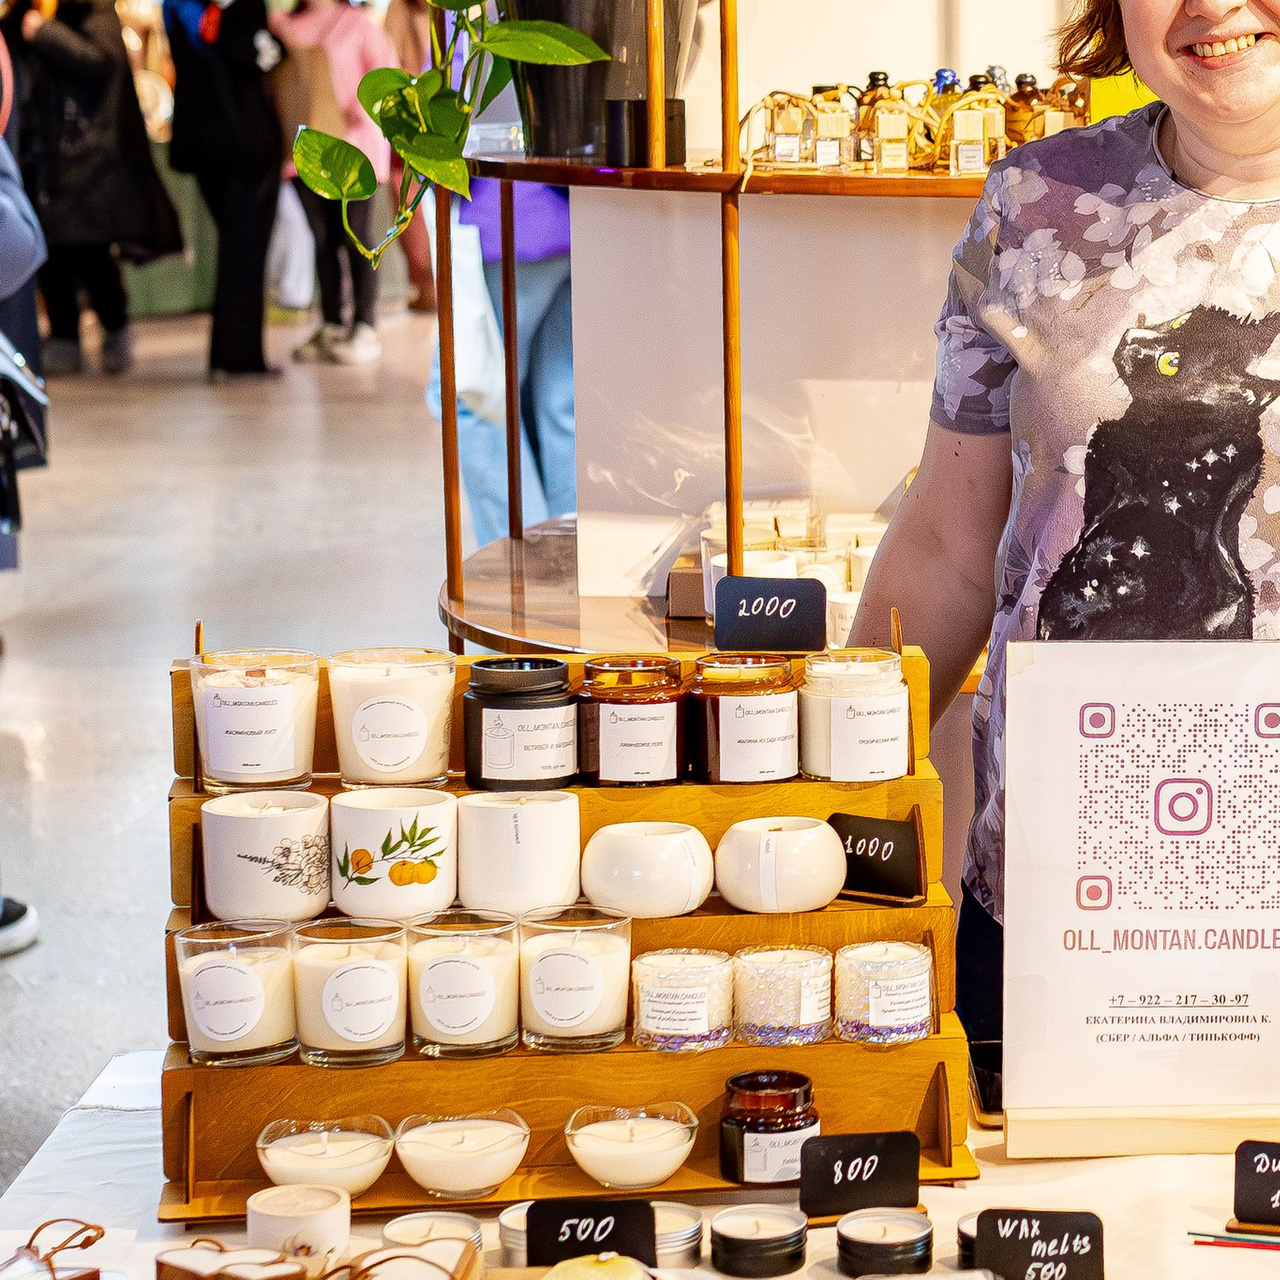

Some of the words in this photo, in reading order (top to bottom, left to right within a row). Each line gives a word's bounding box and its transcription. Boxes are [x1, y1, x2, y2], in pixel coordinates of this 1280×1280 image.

[738, 596, 797, 618] 2000
[845, 835, 894, 861] 1000
[1109, 994, 1124, 1006] +7
[1139, 994, 1161, 1006] 922
[1176, 994, 1197, 1006] 217
[1211, 994, 1226, 1006] 30
[1230, 994, 1249, 1006] -97
[1085, 1015, 1156, 1025] ЕКАТЕРИНА
[1159, 1015, 1258, 1026] ВЛАДИМИРОВНА
[1261, 1015, 1272, 1024] К.
[1096, 1033, 1130, 1043] (СБЕР
[1138, 1033, 1179, 1042] АЛЬФА
[1188, 1033, 1261, 1042] ТИНЬКОФФ)
[834, 1155, 878, 1184] 800
[558, 1216, 615, 1242] 500
[1030, 1232, 1092, 1258] melts
